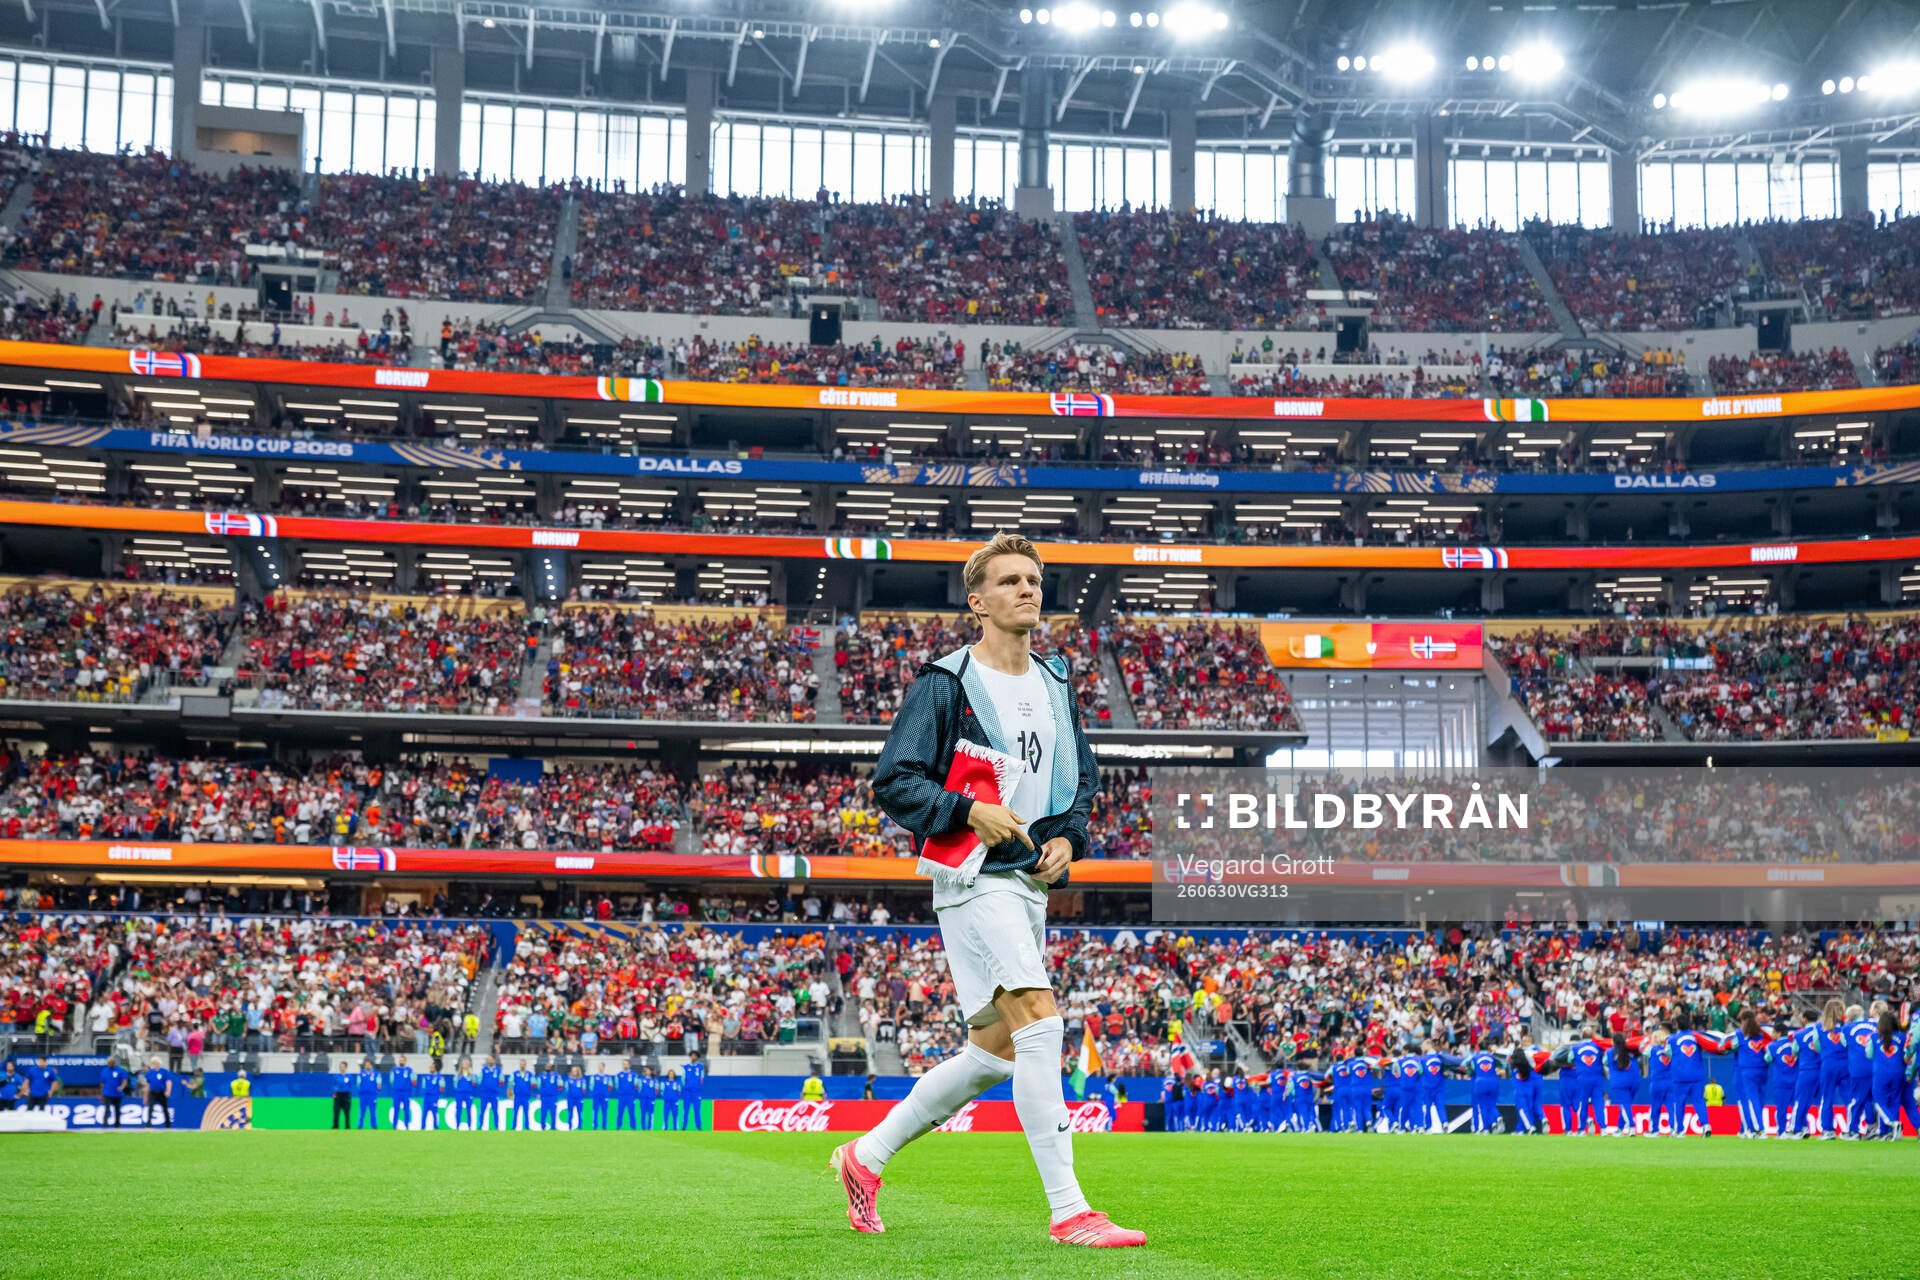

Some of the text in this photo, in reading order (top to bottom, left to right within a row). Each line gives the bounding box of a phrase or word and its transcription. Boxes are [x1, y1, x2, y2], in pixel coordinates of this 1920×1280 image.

[375, 369, 429, 387] NORWAY
[819, 387, 848, 405] CÔTE
[1274, 400, 1324, 416] NORWAY
[1702, 397, 1731, 416] CÔTE
[151, 433, 353, 456] FIFA WORLD CUP 2026
[639, 458, 742, 474] DALLAS
[1139, 472, 1219, 488] #FIFAWorldCup
[1615, 474, 1717, 488] DALLAS
[532, 531, 580, 547] NORWAY
[1750, 546, 1798, 562] NORWAY
[1017, 731, 1042, 773] 10
[738, 1100, 834, 1132] Coca-Cola
